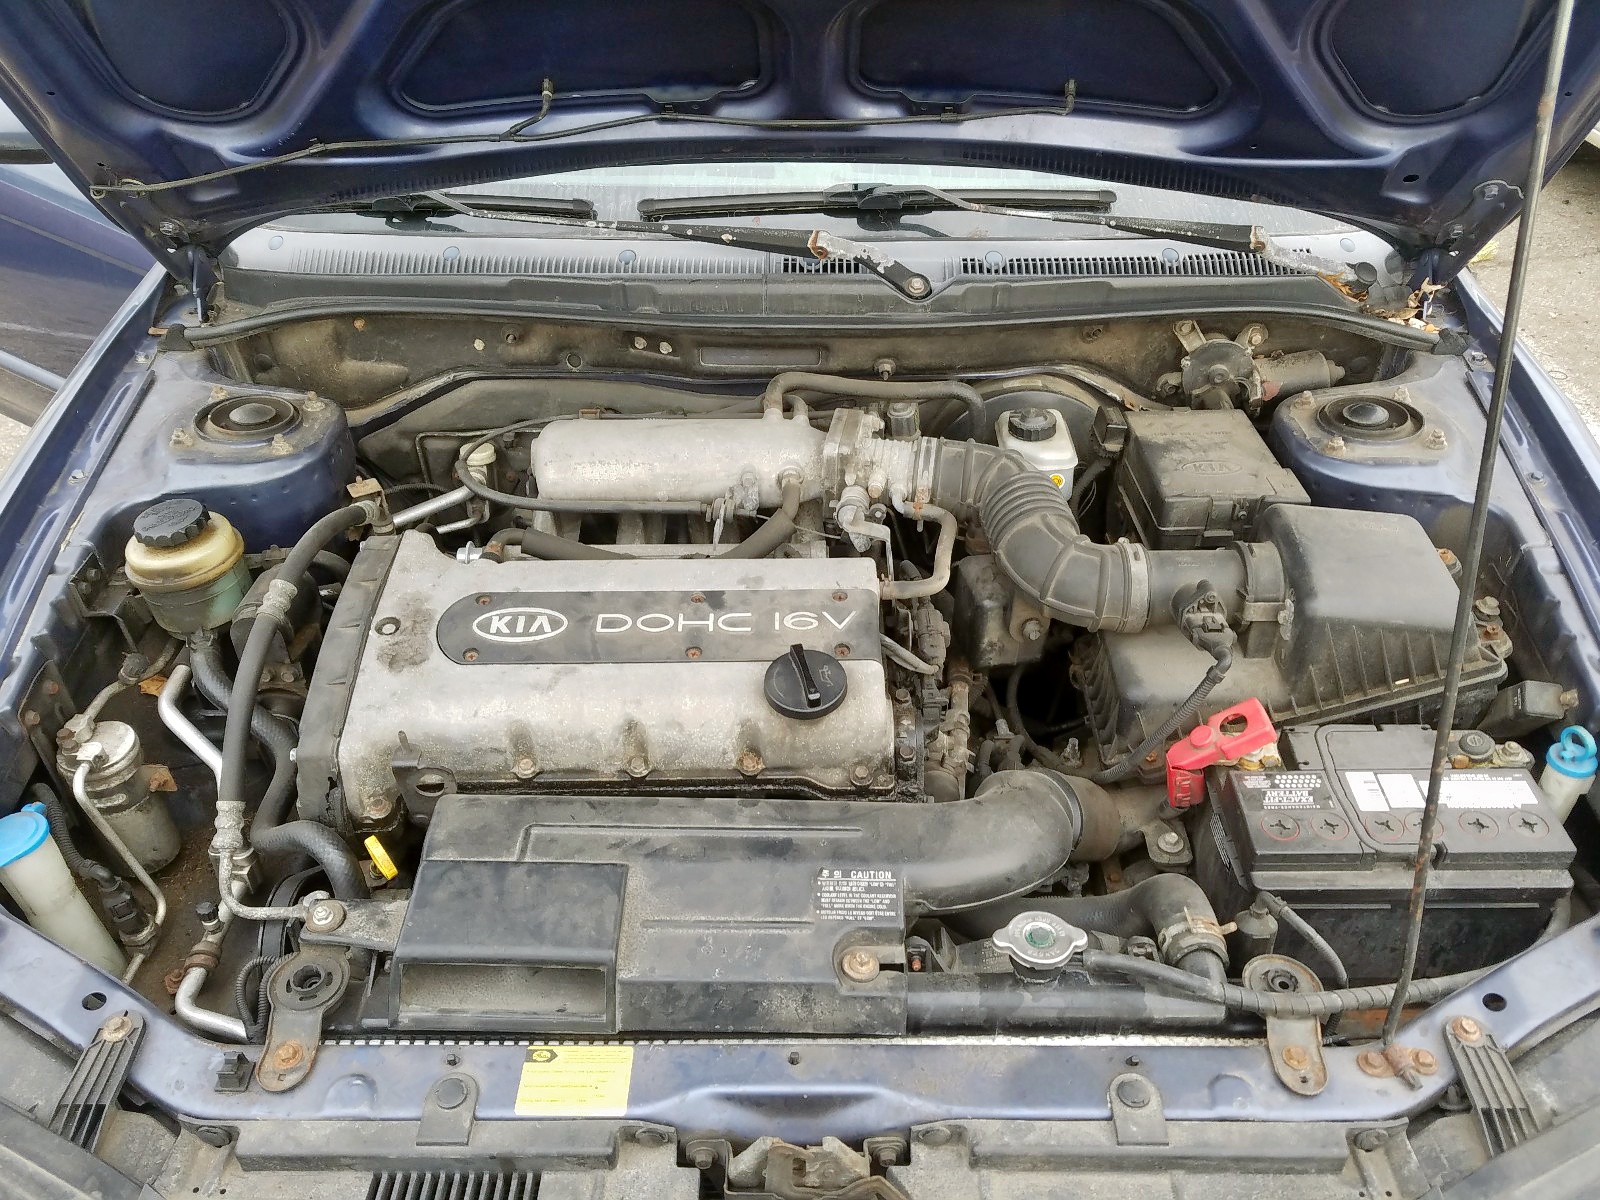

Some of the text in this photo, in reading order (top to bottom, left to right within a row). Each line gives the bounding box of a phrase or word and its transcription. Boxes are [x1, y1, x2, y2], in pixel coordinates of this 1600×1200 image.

[488, 613, 554, 635] KIA
[596, 610, 857, 633] DOHC 16V
[850, 870, 892, 879] CAUTION
